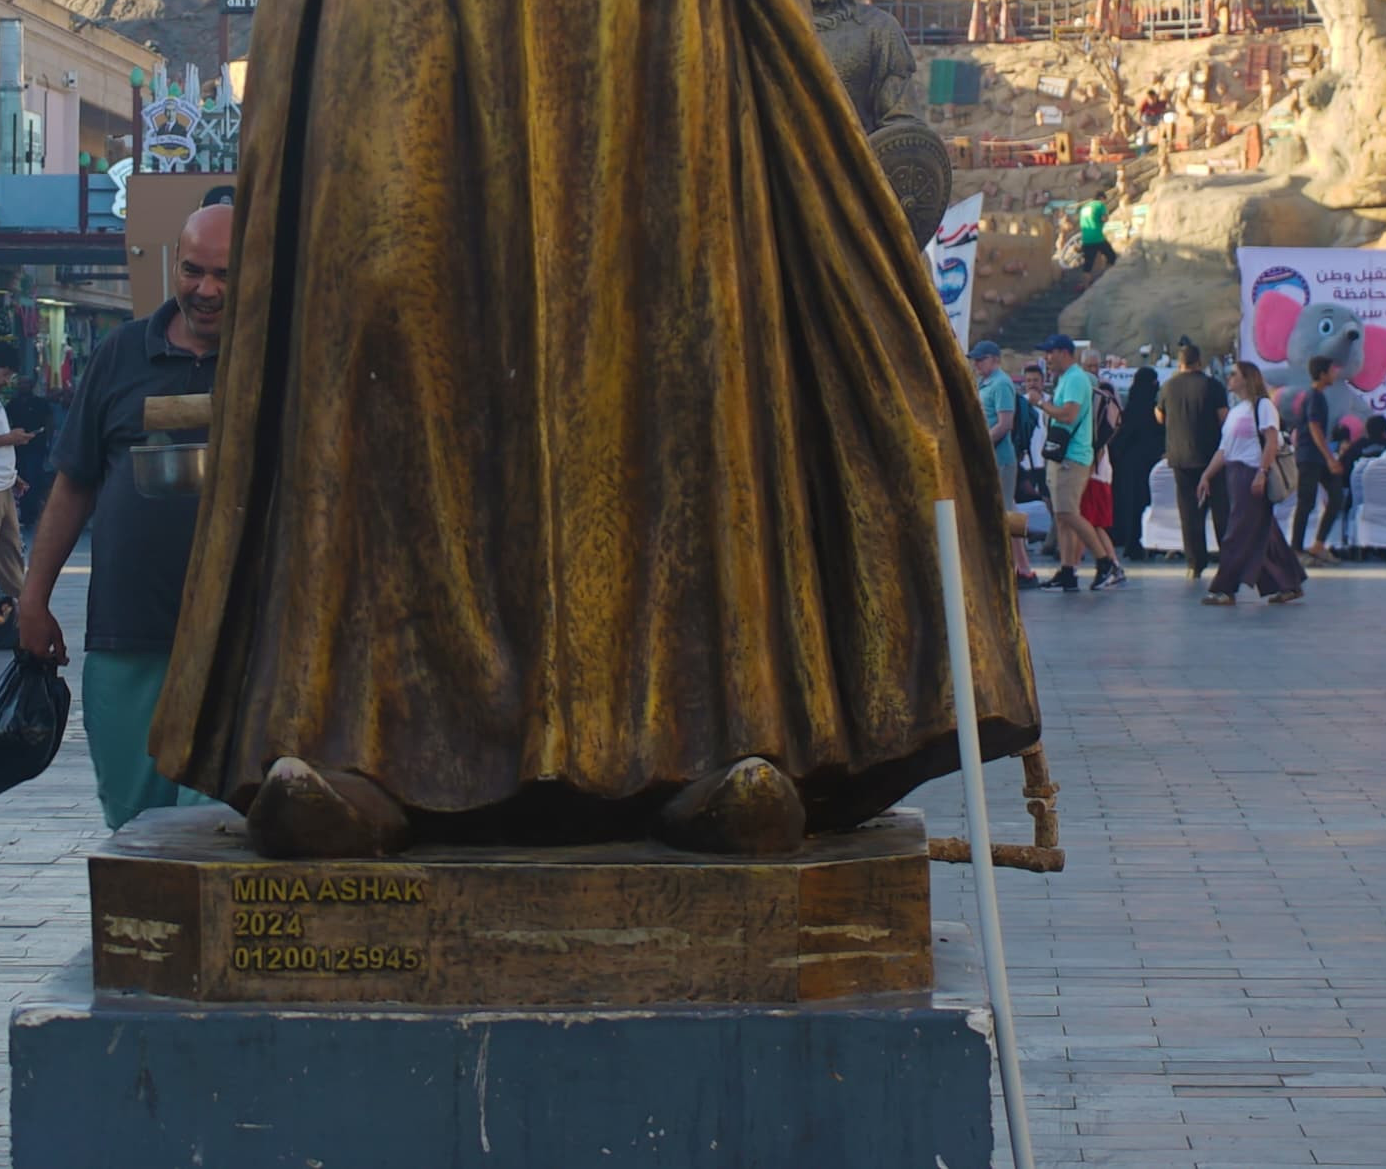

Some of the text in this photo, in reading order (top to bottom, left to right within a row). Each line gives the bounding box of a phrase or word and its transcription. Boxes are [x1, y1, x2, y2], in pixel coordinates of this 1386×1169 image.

[1317, 268, 1351, 284] وطن
[233, 878, 424, 902] MINA ASHAK
[234, 911, 304, 938] 2024
[234, 946, 420, 971] 01200125945
